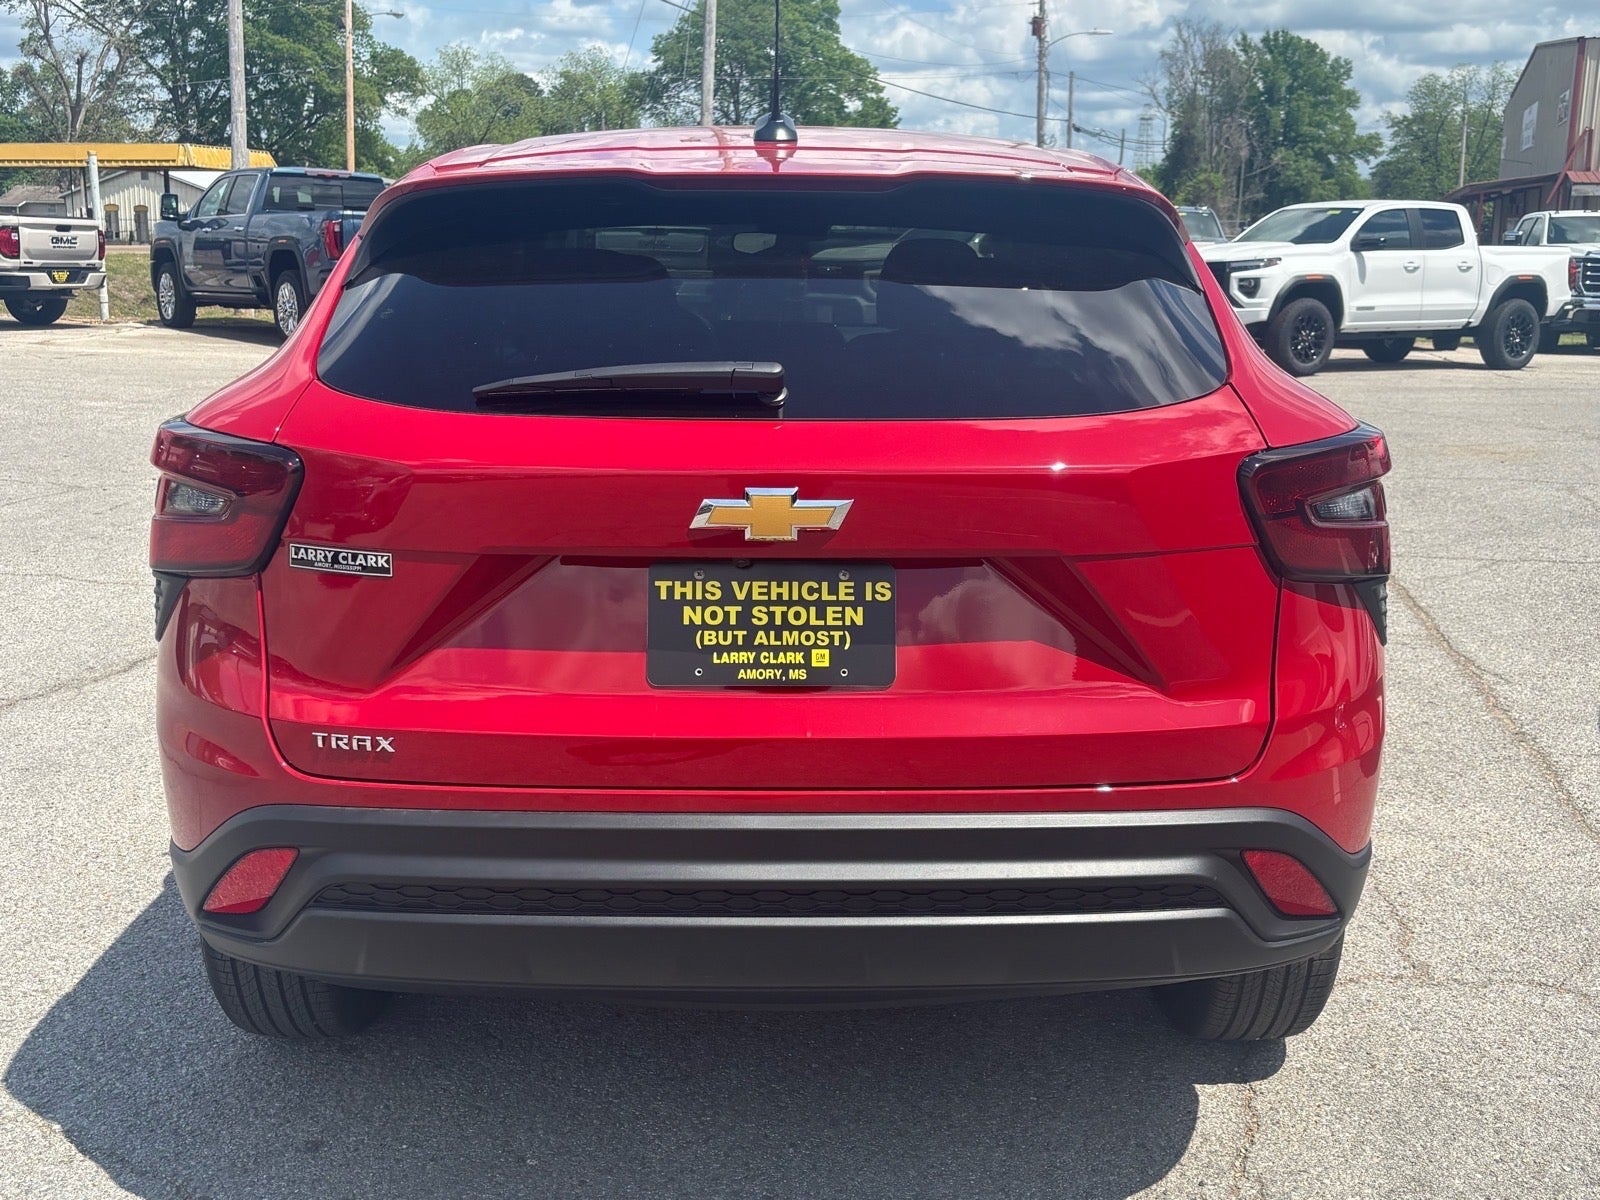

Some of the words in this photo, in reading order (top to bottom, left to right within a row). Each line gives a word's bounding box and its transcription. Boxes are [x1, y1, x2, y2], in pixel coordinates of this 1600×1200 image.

[50, 236, 78, 245] GMC
[291, 547, 335, 563] LARRY
[338, 552, 390, 568] CLARK
[333, 563, 362, 571] MISSISSIPPI
[654, 580, 722, 601] THIS
[731, 580, 855, 601] VEHICLE
[865, 581, 892, 601] IS
[683, 605, 742, 625] NOT
[751, 606, 864, 626] STOLEN
[695, 630, 747, 649] (BUT
[754, 630, 851, 650] ALMOST)
[712, 651, 756, 664] LARRY
[760, 651, 805, 664] CLARK
[737, 668, 786, 681] AMORY,
[788, 668, 807, 680] MS
[311, 732, 396, 753] TRAX
